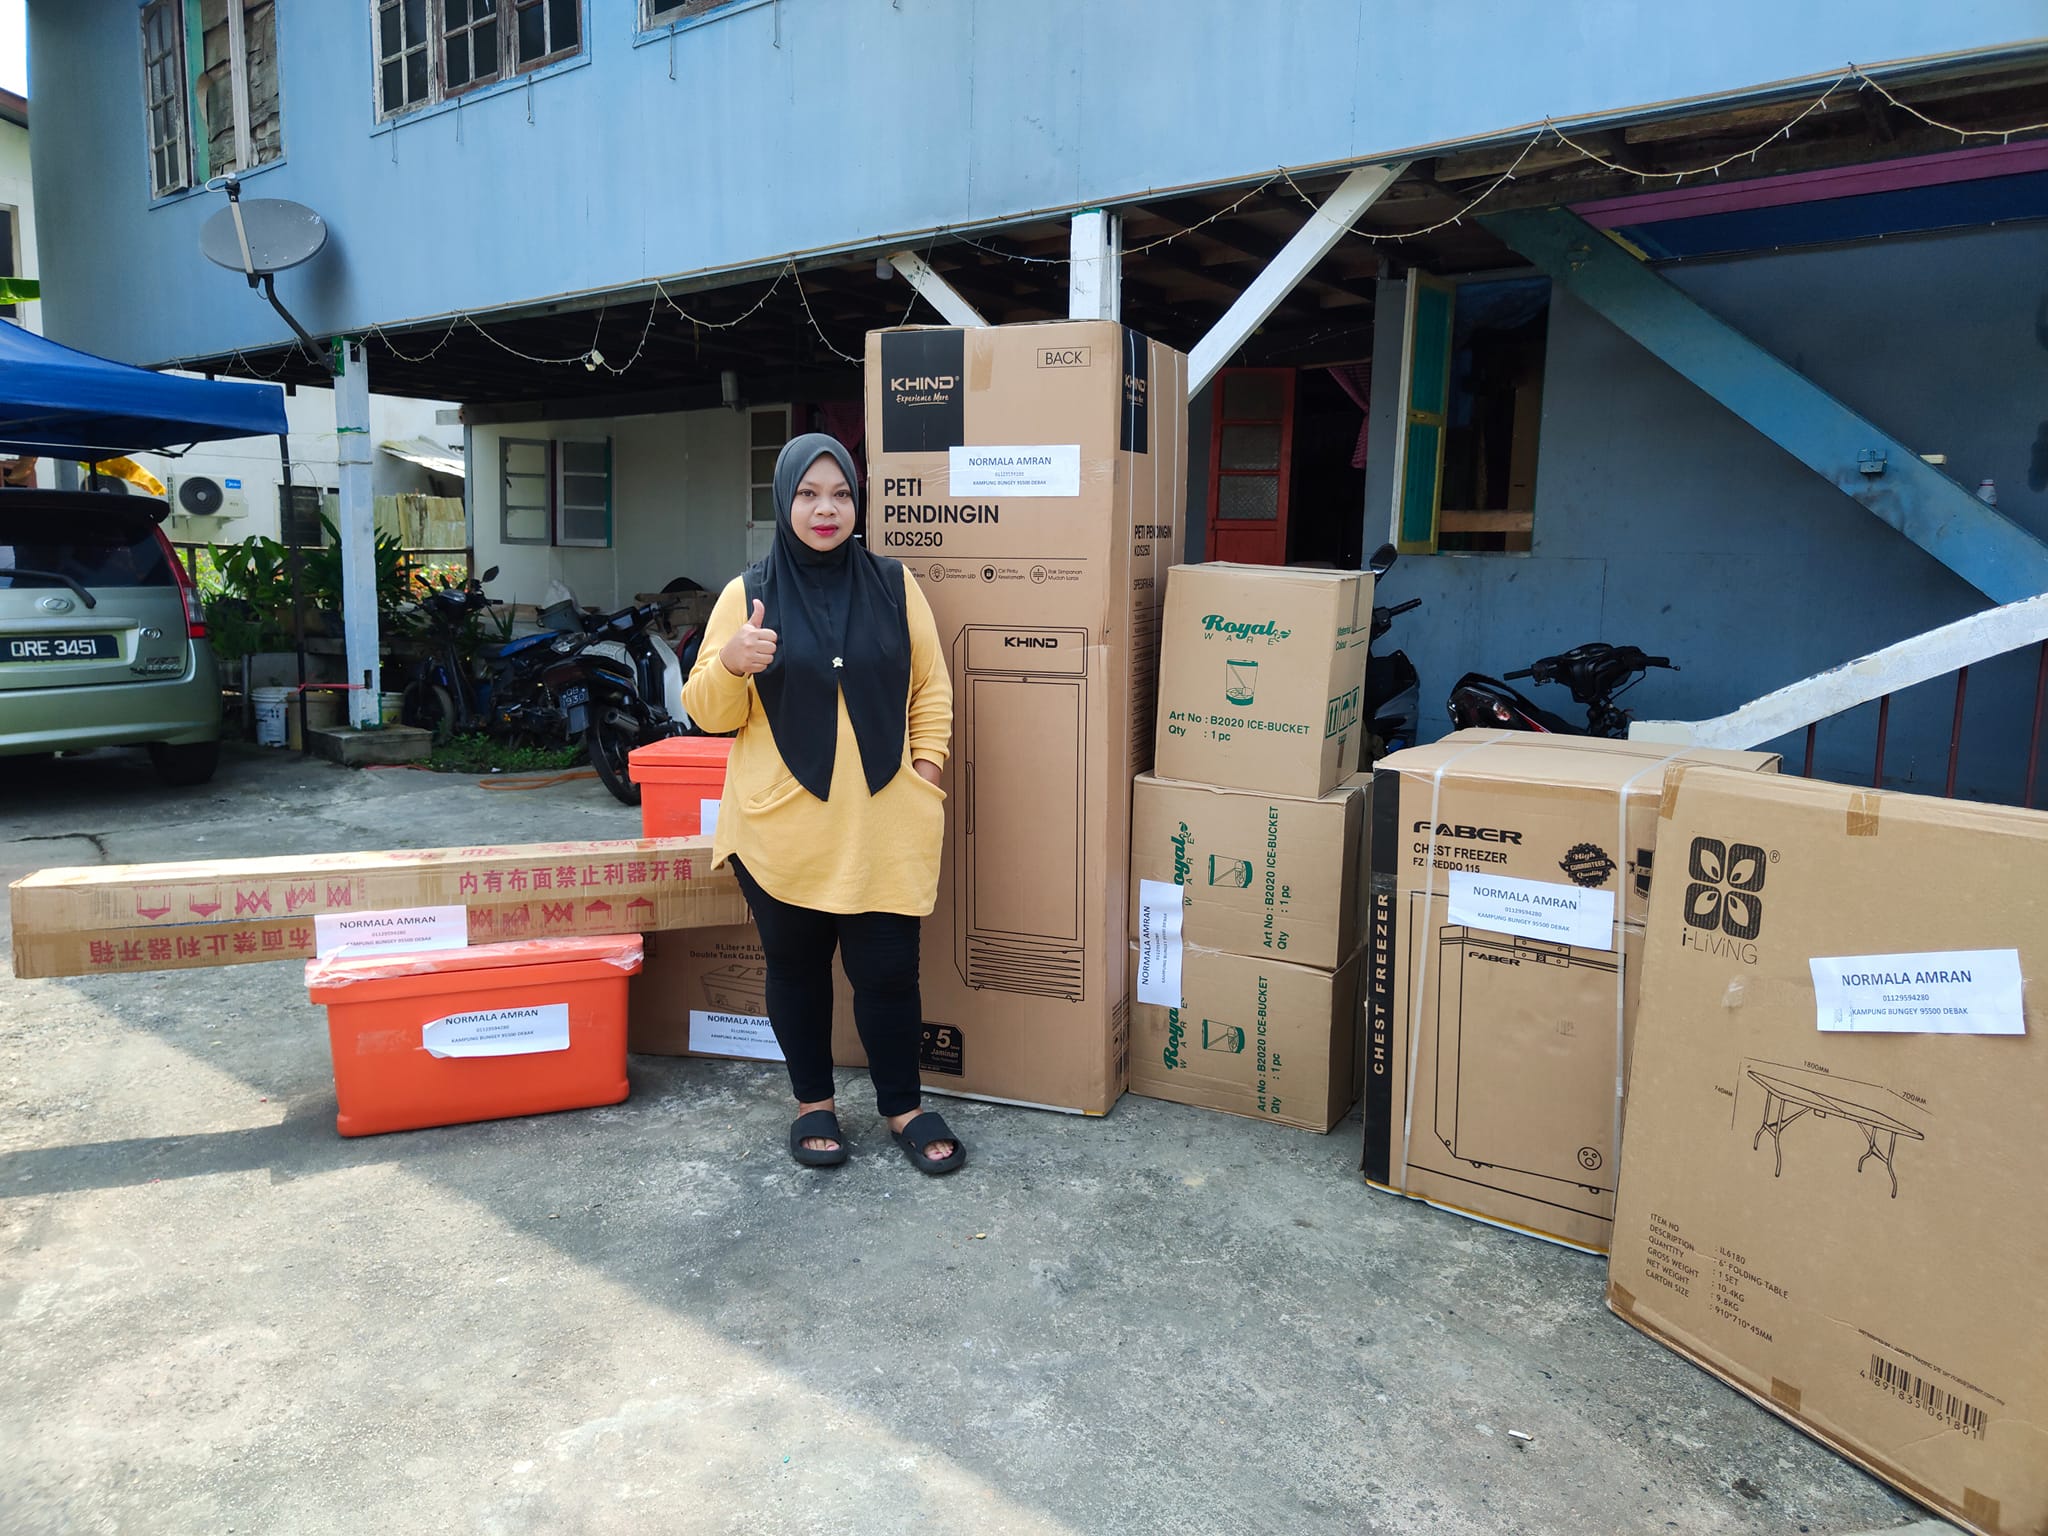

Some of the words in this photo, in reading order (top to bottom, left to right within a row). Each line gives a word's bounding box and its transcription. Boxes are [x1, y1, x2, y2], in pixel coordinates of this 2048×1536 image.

[1044, 351, 1083, 366] BACK
[890, 375, 955, 391] KHIND
[896, 393, 932, 405] Experience
[933, 392, 949, 402] More
[969, 457, 1014, 466] NORMALA
[1016, 456, 1051, 465] AMRAN
[884, 478, 922, 497] PETI
[884, 505, 999, 524] PENDINGIN
[884, 531, 943, 547] KDS250
[1134, 525, 1145, 539] PETI
[1201, 614, 1277, 640] Royal
[11, 639, 51, 657] QRE
[55, 639, 97, 656] 3451
[1004, 637, 1058, 649] KHIND
[1169, 711, 1185, 721] Art
[1187, 713, 1202, 723] No
[1210, 715, 1244, 728] B2020
[1247, 720, 1310, 735] ICE-BUCKET
[1168, 725, 1186, 737] Qty
[1218, 733, 1231, 742] pc
[1266, 806, 1278, 869] ICE-BUCKET
[1413, 821, 1523, 846] FABER
[1171, 832, 1190, 886] oyal
[1454, 847, 1508, 865] FREEZER
[1573, 852, 1596, 861] High
[1413, 857, 1424, 867] FZ
[1426, 858, 1463, 872] REDDO
[1465, 864, 1480, 874] 115
[459, 858, 693, 896] 内有布面禁止利器开箱
[1265, 871, 1275, 906] B2020
[1281, 885, 1291, 899] pc
[1473, 886, 1530, 903] NORMALA
[1532, 895, 1577, 910] AMRAN
[340, 918, 394, 929] NORMALA
[396, 915, 436, 926] AMRAN
[1143, 906, 1151, 939] AMRAN
[1264, 914, 1273, 929] No
[1477, 912, 1507, 922] KAMPUNG
[1508, 917, 1531, 926] BUNGEY
[1263, 931, 1272, 948] Art
[1277, 931, 1290, 950] Qty
[1374, 893, 1389, 994] FREEZER
[690, 951, 717, 959] Double
[1142, 940, 1151, 985] NORMALA
[1469, 951, 1521, 966] FABER
[1841, 972, 1912, 986] NORMALA
[1915, 970, 1972, 984] AMRAN
[1257, 976, 1268, 1037] ICE-BUCKET
[1882, 994, 1929, 1002] 01129594280
[445, 1013, 498, 1025] NORMALA
[499, 1009, 539, 1020] AMRAN
[1943, 1007, 1968, 1015] DEBAK
[707, 1015, 749, 1025] NORMALA
[750, 1018, 772, 1027] AMR
[936, 1029, 951, 1048] 5
[1163, 1007, 1184, 1070] Roya
[1373, 1004, 1386, 1076] CHEST
[1257, 1039, 1266, 1072] B2020
[1273, 1053, 1282, 1067] pc
[1803, 1060, 1830, 1074] 1800MM
[1257, 1080, 1266, 1094] No
[1257, 1096, 1266, 1112] Art
[1271, 1097, 1282, 1114] Qty
[1902, 1091, 1927, 1105] 700MM
[1650, 1213, 1667, 1227] ITEM
[1668, 1222, 1679, 1232] NO
[1720, 1247, 1746, 1265] IL6180
[1649, 1235, 1684, 1258] QUANTITY
[1724, 1274, 1739, 1286] SET
[1650, 1224, 1695, 1251] DESCRIPTION
[1728, 1263, 1764, 1286] FOLDING
[1764, 1281, 1789, 1300] TABLE
[1647, 1258, 1660, 1270] NET
[1662, 1266, 1690, 1285] WEIGHT
[1648, 1246, 1670, 1263] GROSS
[1671, 1258, 1699, 1278] WEIGHT
[1717, 1283, 1745, 1303] 10.4KG
[1645, 1269, 1673, 1289] CARTON
[1674, 1283, 1689, 1298] SIZE
[1927, 1406, 1977, 1440] 061801
